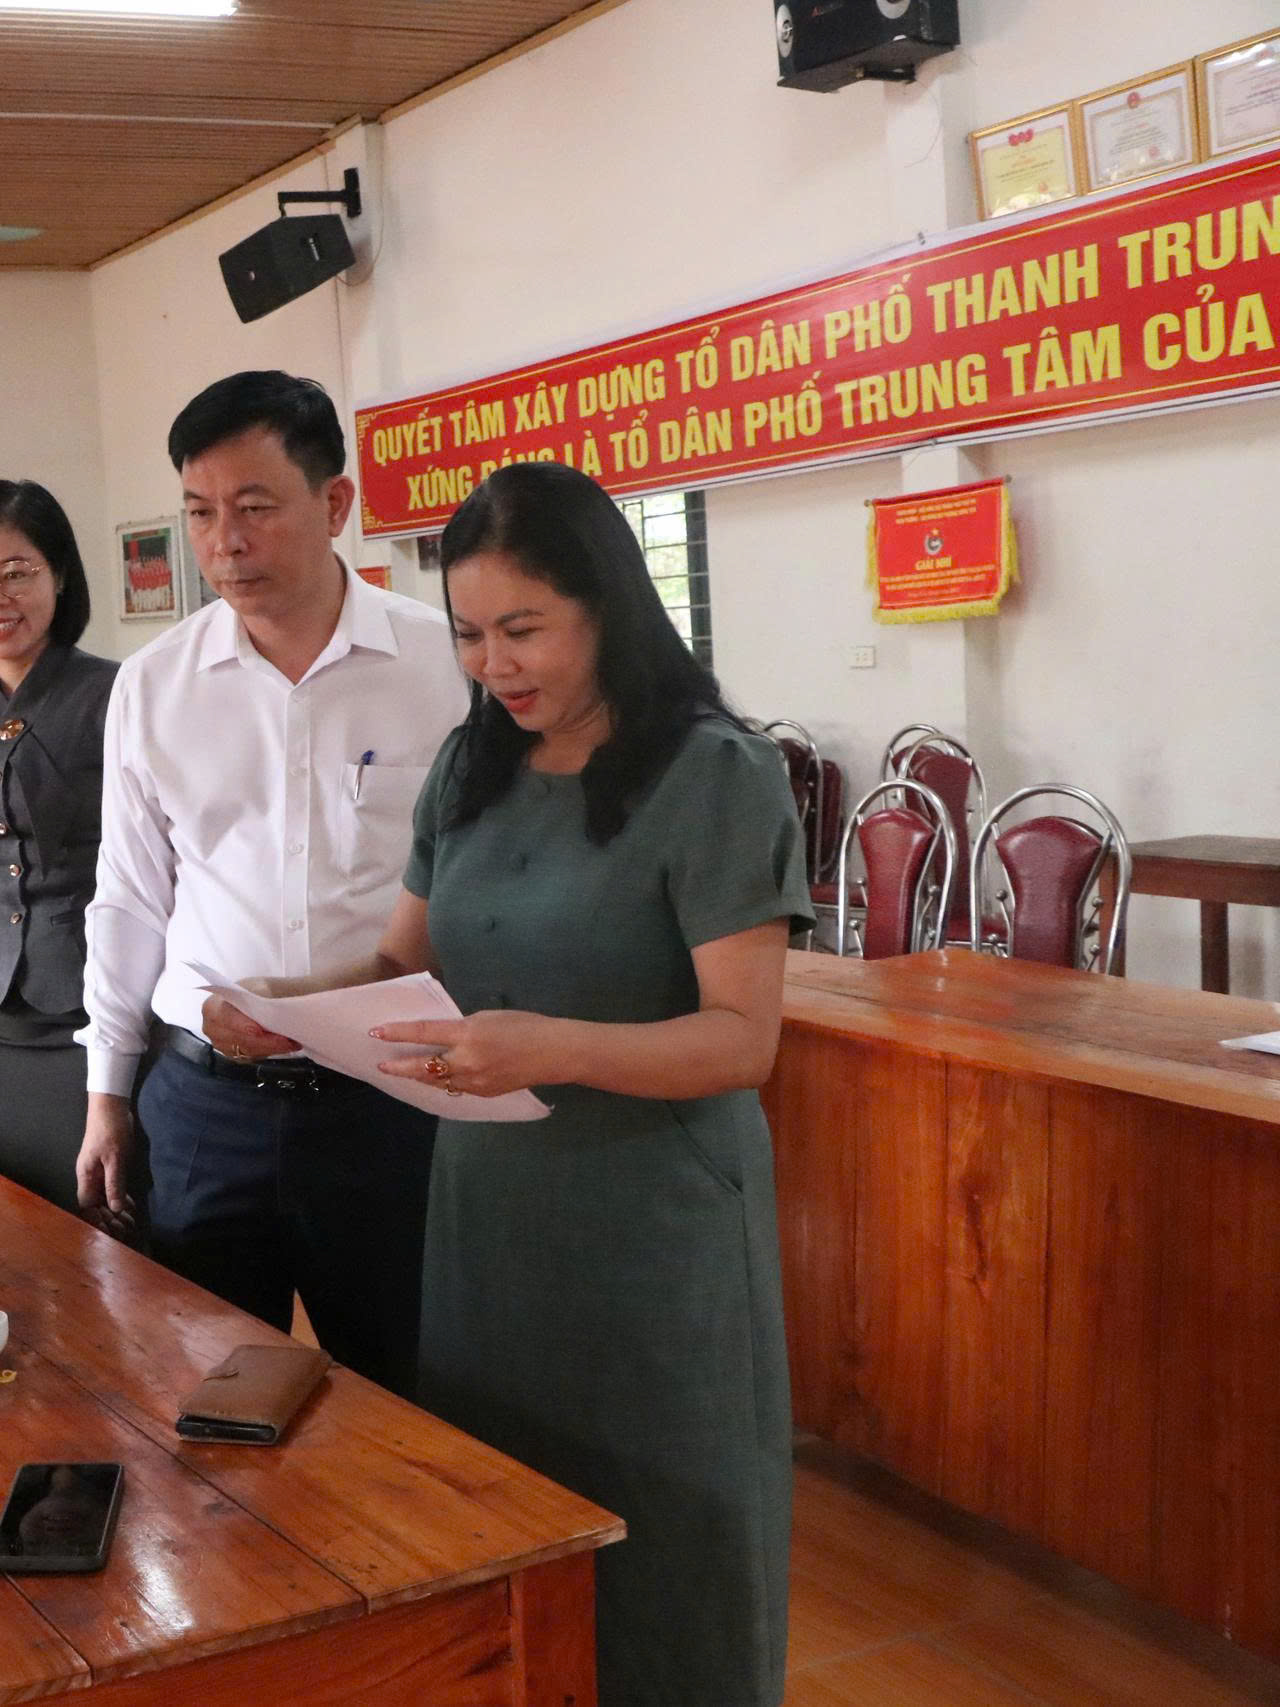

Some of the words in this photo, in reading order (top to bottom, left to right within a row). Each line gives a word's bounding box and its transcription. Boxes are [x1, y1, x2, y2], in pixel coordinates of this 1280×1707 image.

[373, 407, 442, 466] QUYẾT
[450, 400, 506, 447] TÂM
[514, 381, 568, 433] XÂY
[578, 359, 665, 422] DỰNG
[676, 326, 719, 394] TỔ
[730, 320, 811, 382] DÂN
[824, 274, 912, 359] PHỐ
[926, 243, 1099, 334] THANH
[407, 465, 473, 511] XỨNG
[609, 410, 649, 472] TỔ
[659, 406, 733, 463] DÂN
[744, 370, 822, 447] PHỐ
[834, 353, 988, 429] TRUNG
[1003, 324, 1122, 397] TÂM
[1143, 284, 1275, 371] CỦA
